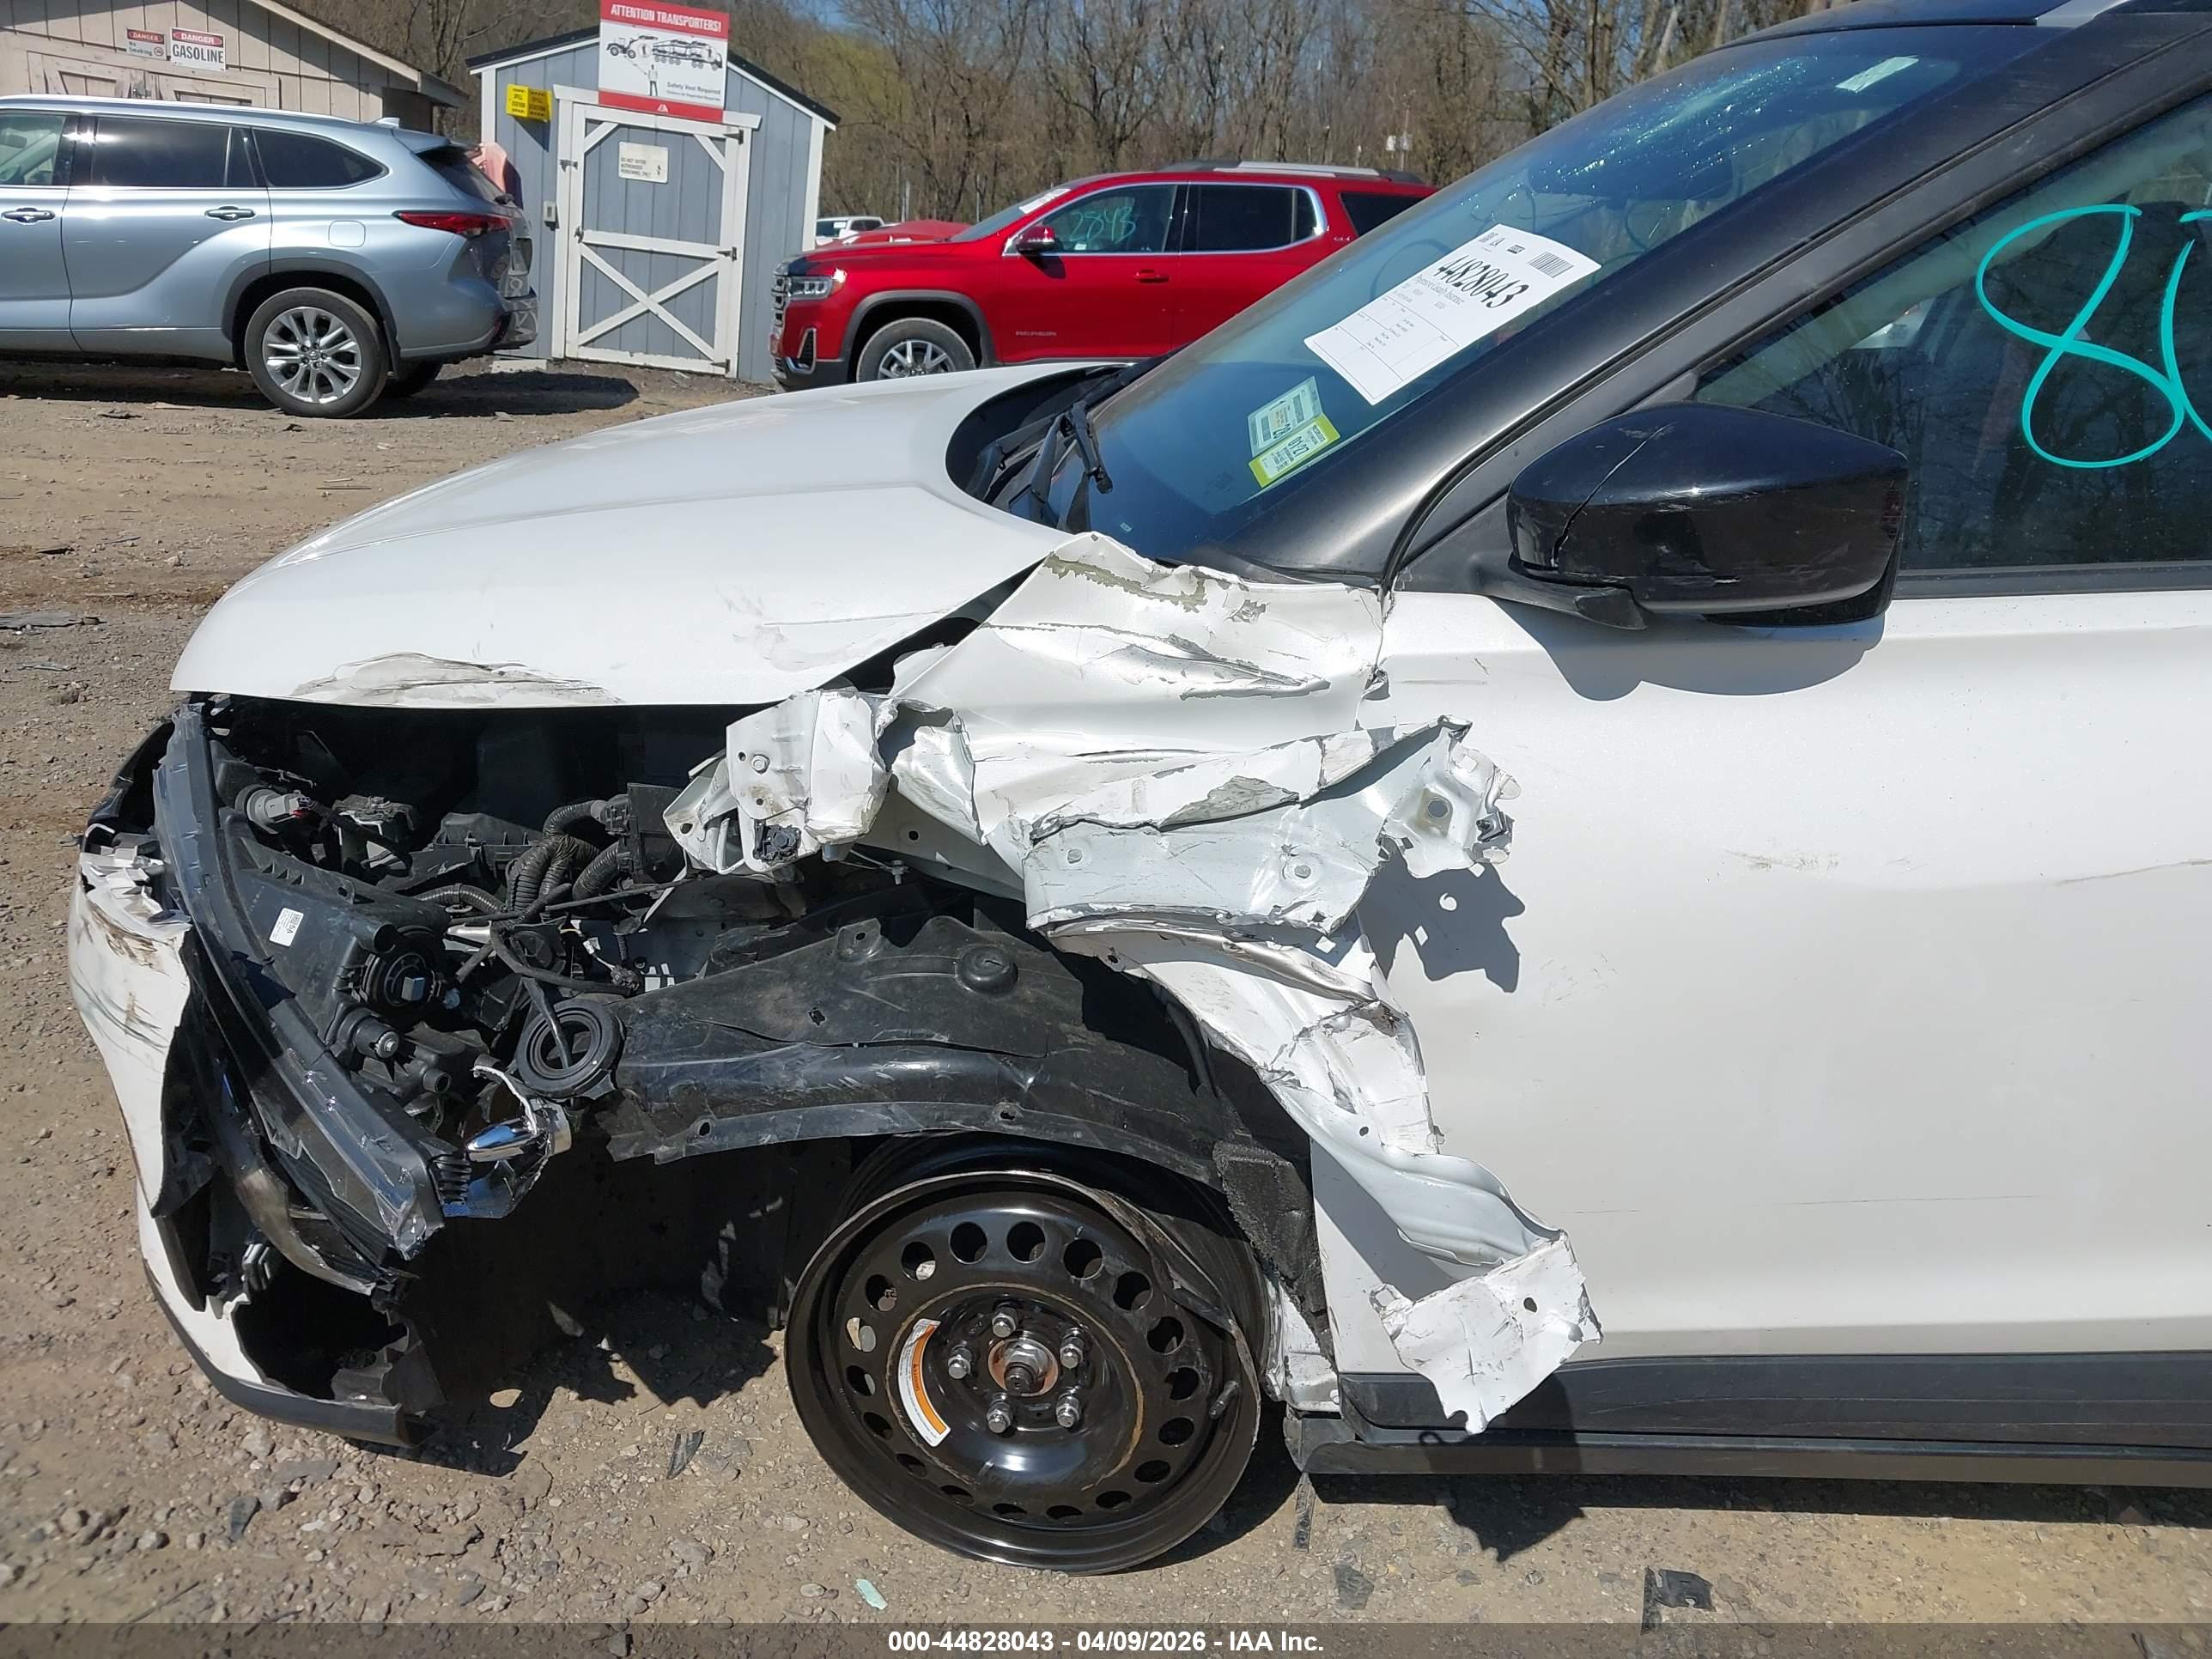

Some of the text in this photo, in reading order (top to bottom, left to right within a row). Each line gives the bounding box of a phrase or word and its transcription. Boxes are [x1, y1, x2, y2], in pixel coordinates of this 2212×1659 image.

[611, 3, 721, 33] ATTENTION TRANSPORTERS!
[132, 33, 160, 41] DANGER
[180, 33, 215, 44] DANGER
[173, 44, 224, 64] GASOLINE
[1433, 255, 1529, 308] 44828043
